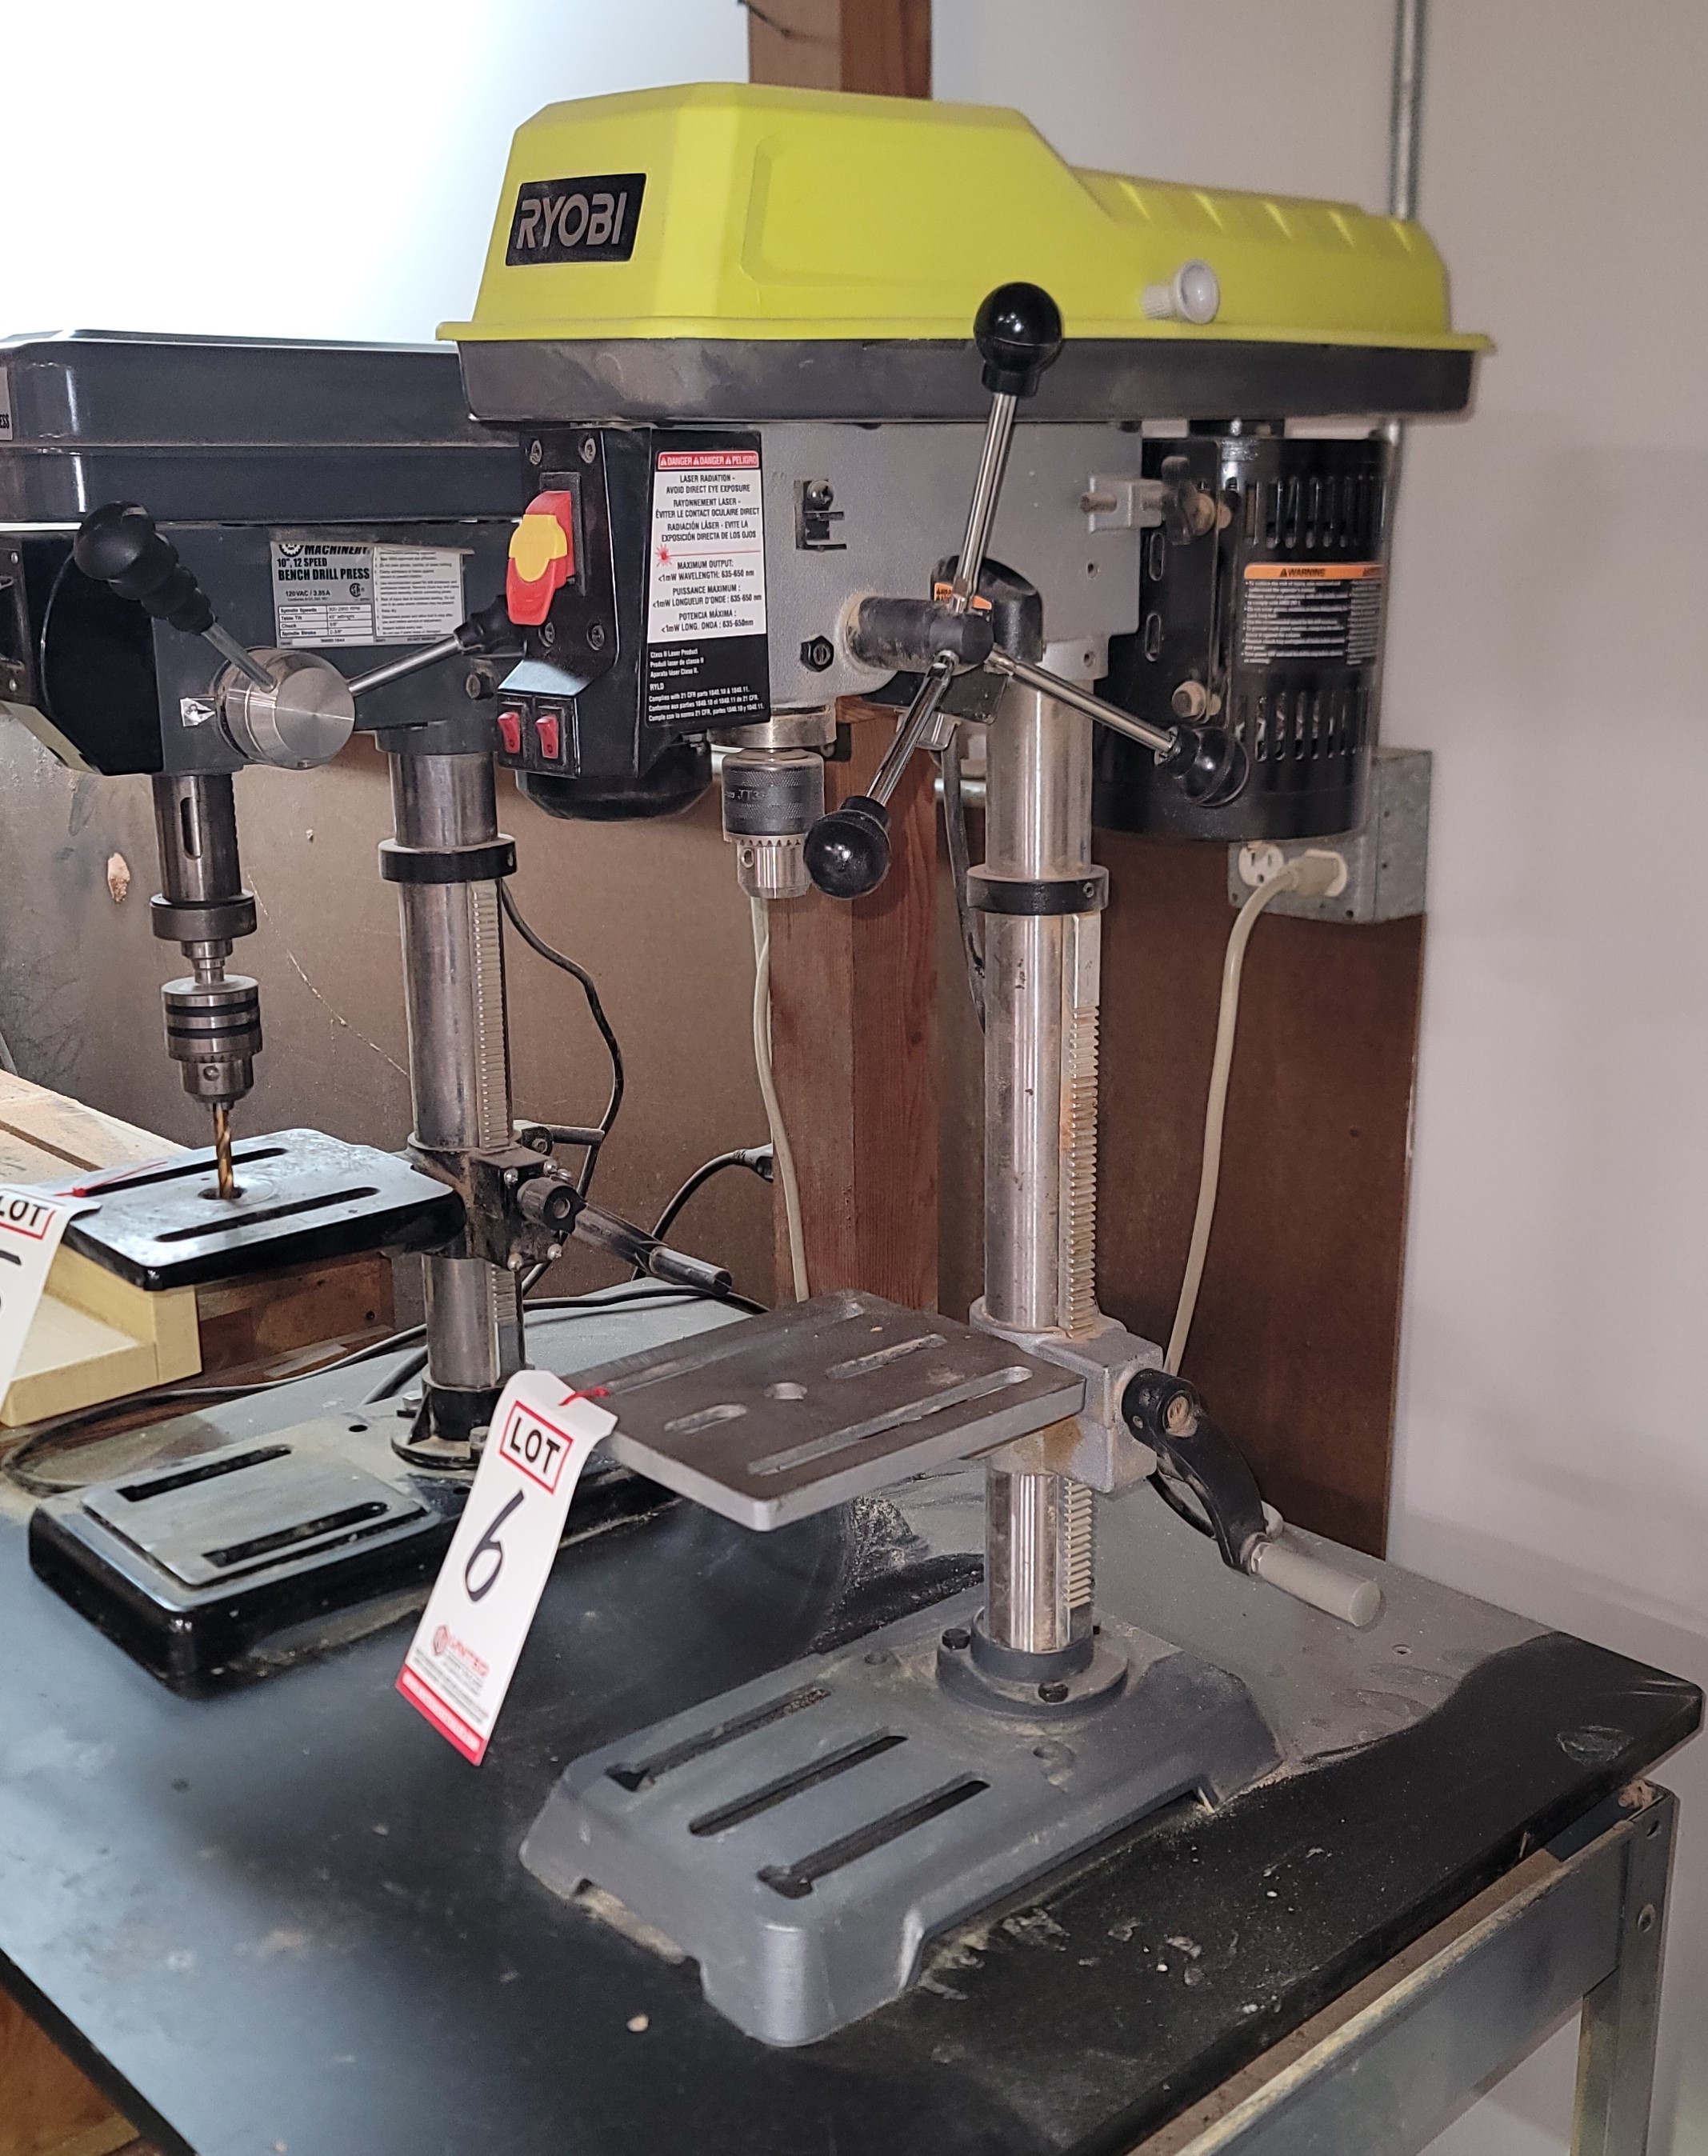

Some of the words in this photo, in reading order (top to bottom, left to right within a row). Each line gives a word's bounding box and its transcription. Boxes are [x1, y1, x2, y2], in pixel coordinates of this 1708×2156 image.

[516, 192, 627, 249] RYOBI
[667, 457, 693, 466] DANGER
[699, 456, 724, 465] DANGER
[732, 456, 757, 464] PELIGRO
[700, 474, 731, 482] RADIATION
[686, 486, 706, 494] DIRECT
[707, 485, 718, 493] EYE
[720, 484, 750, 493] EXPOSURE
[673, 498, 717, 507] RAYONNEMENT
[656, 510, 675, 518] ÉVITER
[685, 510, 710, 518] CONTACT
[711, 508, 738, 517] OCULAIRE
[739, 507, 760, 515] DIRECT
[667, 522, 699, 531] RADIACIÓN
[701, 520, 719, 530] LÁSER
[725, 521, 739, 529] EVITE
[741, 520, 749, 528] LA
[662, 532, 695, 542] EXPOSICIÓN
[697, 532, 720, 541] DIRECTA
[730, 531, 741, 539] LOS
[742, 530, 756, 538] OJOS
[293, 558, 302, 567] 12
[303, 558, 328, 566] SPEED
[677, 561, 708, 570] MAXIMUM
[709, 560, 734, 568] OUTPUT:
[278, 569, 310, 581] BENCH
[312, 568, 338, 580] DRILL
[340, 568, 370, 579] PRESS
[658, 573, 677, 582] <1mW
[678, 570, 720, 581] WAVELENGTH:
[722, 570, 744, 578] 635-650
[1289, 569, 1326, 577] WARNING
[672, 586, 706, 595] PUISSANCE
[707, 584, 737, 593] MAXIMUM
[652, 600, 671, 608] <1mW
[672, 597, 703, 606] LONGUEUR
[705, 595, 726, 604] D'ONDE
[730, 594, 752, 602] 635-650
[678, 611, 708, 621] POTENCIA
[709, 608, 733, 618] MÁXIMA
[661, 624, 680, 633] <1mW
[681, 622, 700, 631] LONG.
[702, 621, 718, 630] ONDA
[681, 648, 698, 656] Product
[510, 1417, 561, 1474] LOT
[464, 1489, 525, 1603] 6
